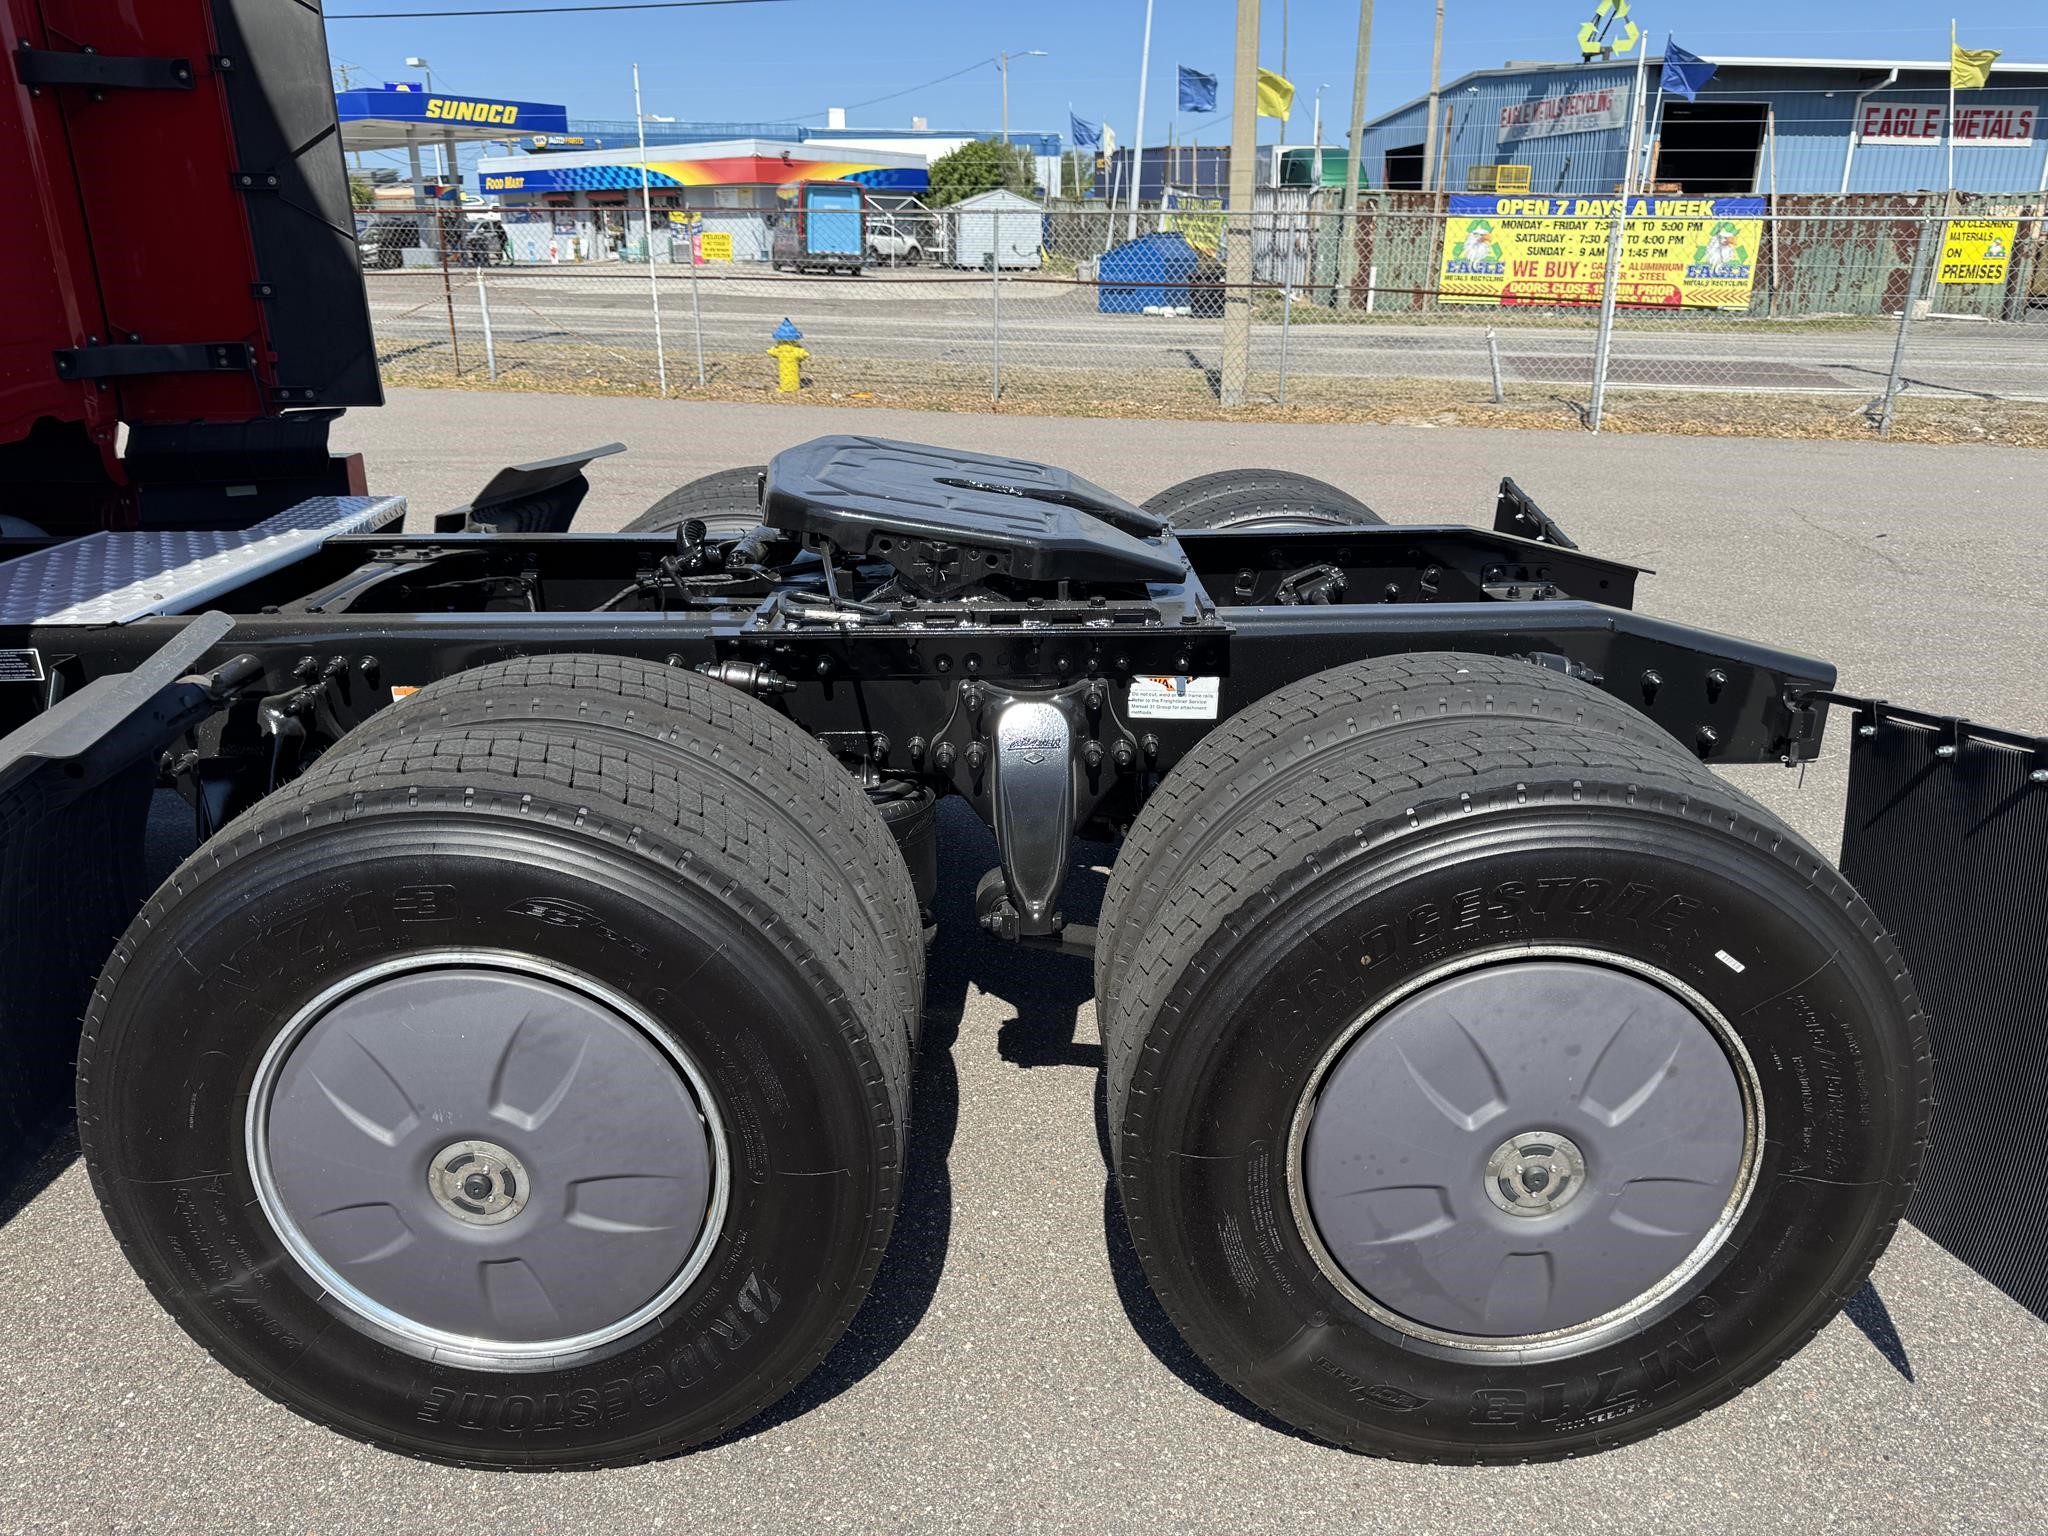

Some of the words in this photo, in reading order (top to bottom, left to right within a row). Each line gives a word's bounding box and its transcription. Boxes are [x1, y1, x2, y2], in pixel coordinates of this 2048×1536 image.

[425, 99, 519, 124] SUNOCO
[1500, 102, 1531, 128] EAGLE
[1564, 90, 1615, 116] RECYCLING
[1863, 107, 1940, 138] EAGLE
[1952, 109, 2033, 139] METALS
[1496, 199, 1550, 215] OPEN
[1556, 200, 1570, 215] 7
[1574, 200, 1625, 216] DAYS
[1632, 200, 1648, 216] A
[1655, 200, 1716, 217] WEEK
[1501, 220, 1543, 230] MONDAY
[1553, 221, 1588, 230] FRIDAY
[1643, 222, 1655, 231] TO
[1661, 222, 1684, 231] 5:00
[1687, 222, 1704, 232] PM
[1952, 220, 1964, 228] NO
[1967, 220, 2013, 228] CLEANING
[1515, 233, 1565, 243] SATURDAY
[1580, 234, 1601, 244] 7:30
[1627, 235, 1640, 244] TO
[1642, 236, 1665, 245] 4:00
[1668, 236, 1685, 245] PM
[1950, 232, 1994, 241] MATERIALS
[1527, 246, 1565, 256] SUNDAY
[1579, 248, 1586, 256] 9
[1588, 248, 1605, 256] AM
[1628, 249, 1649, 257] 1:45
[1651, 249, 1668, 258] PM
[1946, 248, 1962, 258] ON
[1446, 260, 1505, 275] EAGLE
[1513, 260, 1539, 277] WE
[1544, 261, 1580, 278] BUY
[1628, 262, 1684, 272] ALUMINIUM
[1941, 264, 2003, 279] PREMISES
[1638, 271, 1667, 281] STEEL
[1509, 282, 1550, 293] DOORS
[1551, 283, 1589, 294] CLOSE
[1637, 285, 1675, 296] PRIOR
[417, 1271, 781, 1432] BRIDGESTONE
